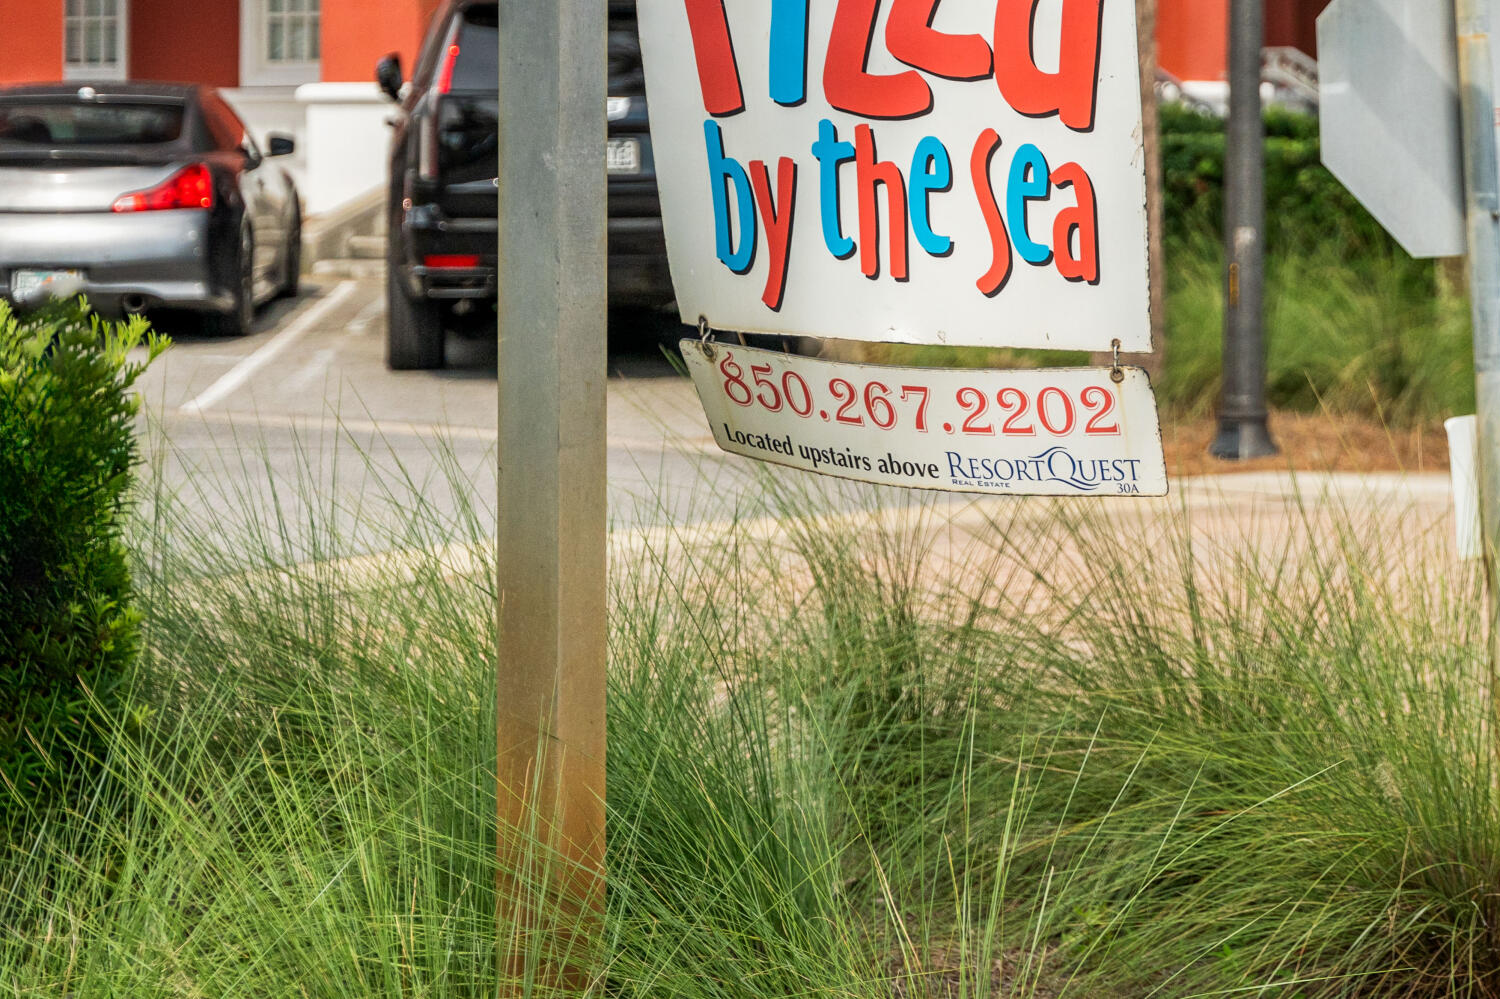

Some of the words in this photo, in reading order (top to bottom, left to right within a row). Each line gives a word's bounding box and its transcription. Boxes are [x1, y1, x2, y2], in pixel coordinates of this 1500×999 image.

[703, 118, 797, 312] by
[811, 118, 954, 283] the
[719, 351, 1121, 438] 850.267.2202
[723, 422, 794, 457] Located
[798, 443, 873, 469] upstairs
[877, 452, 940, 479] above
[1116, 483, 1140, 494] 30A
